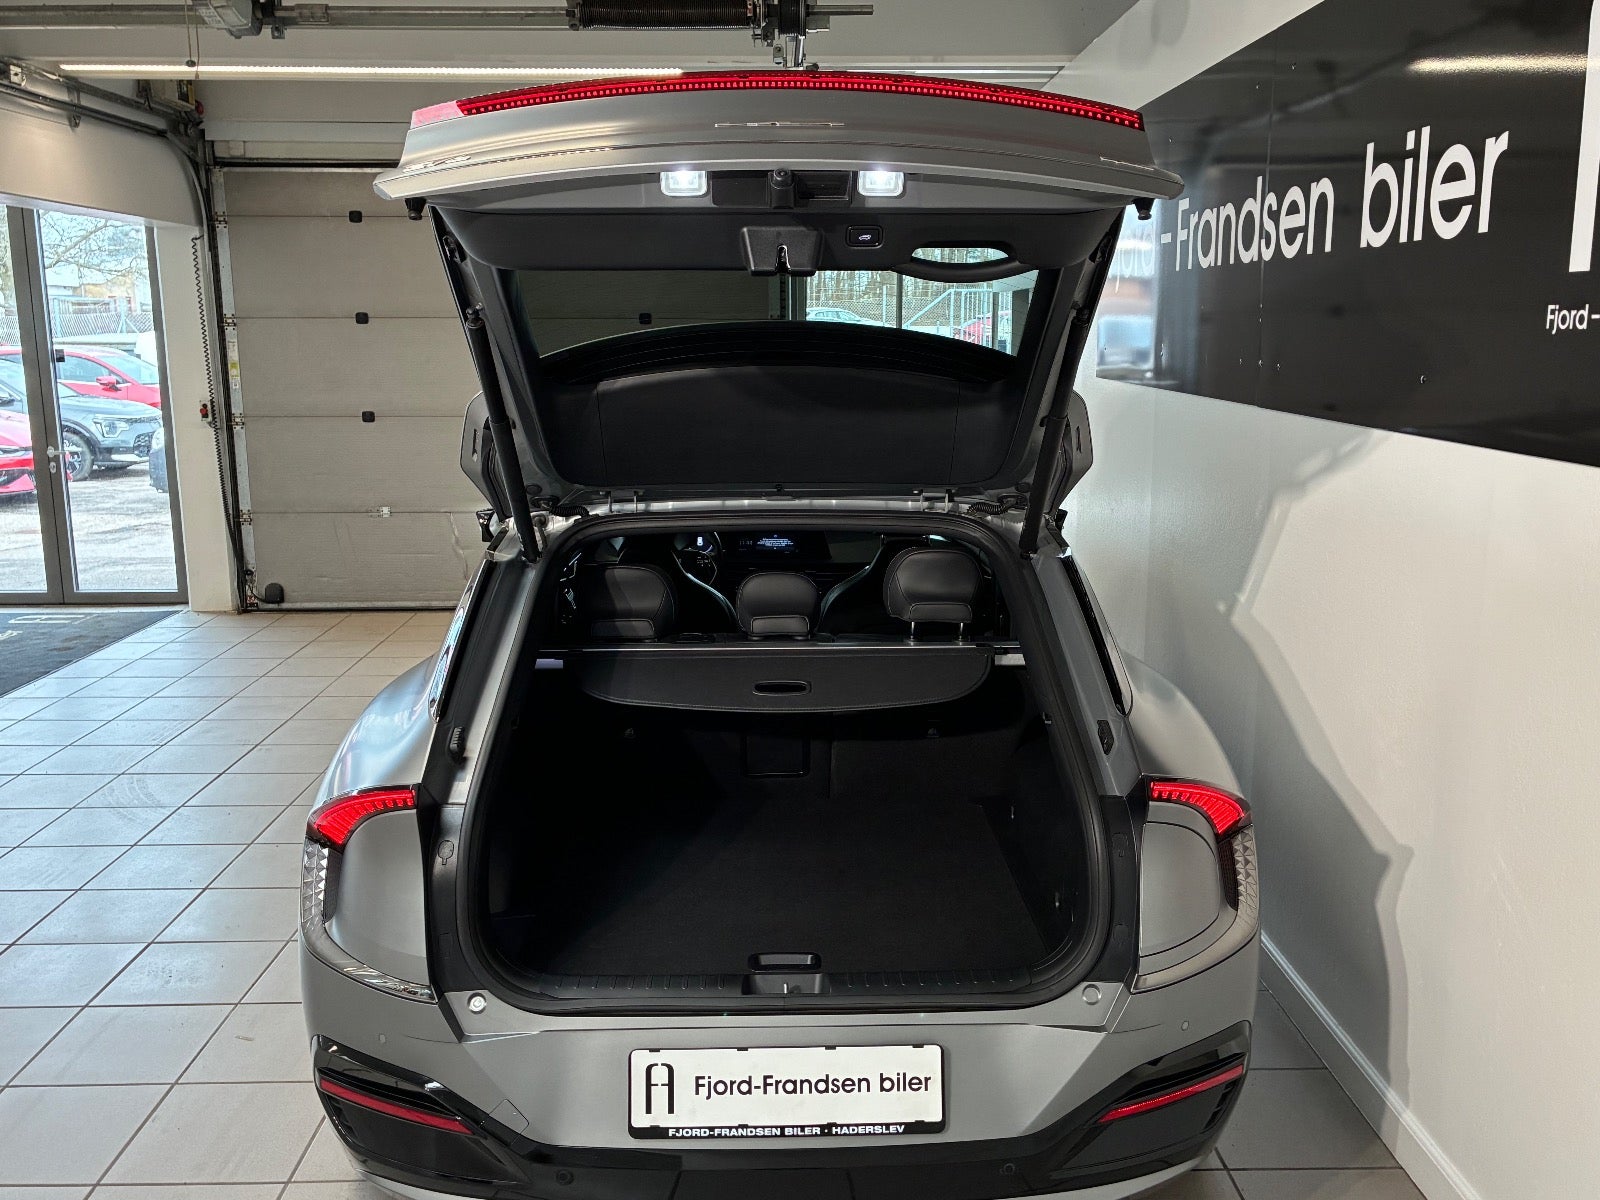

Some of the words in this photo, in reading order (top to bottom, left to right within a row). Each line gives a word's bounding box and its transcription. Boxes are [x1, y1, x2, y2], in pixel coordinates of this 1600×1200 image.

[1359, 125, 1509, 248] biler
[694, 1073, 871, 1100] Fjord-Frandsen
[879, 1072, 932, 1093] biler
[668, 1127, 781, 1137] FJORD-FRANDSEN
[784, 1126, 821, 1136] BILER
[831, 1124, 905, 1135] HADERSLEV
